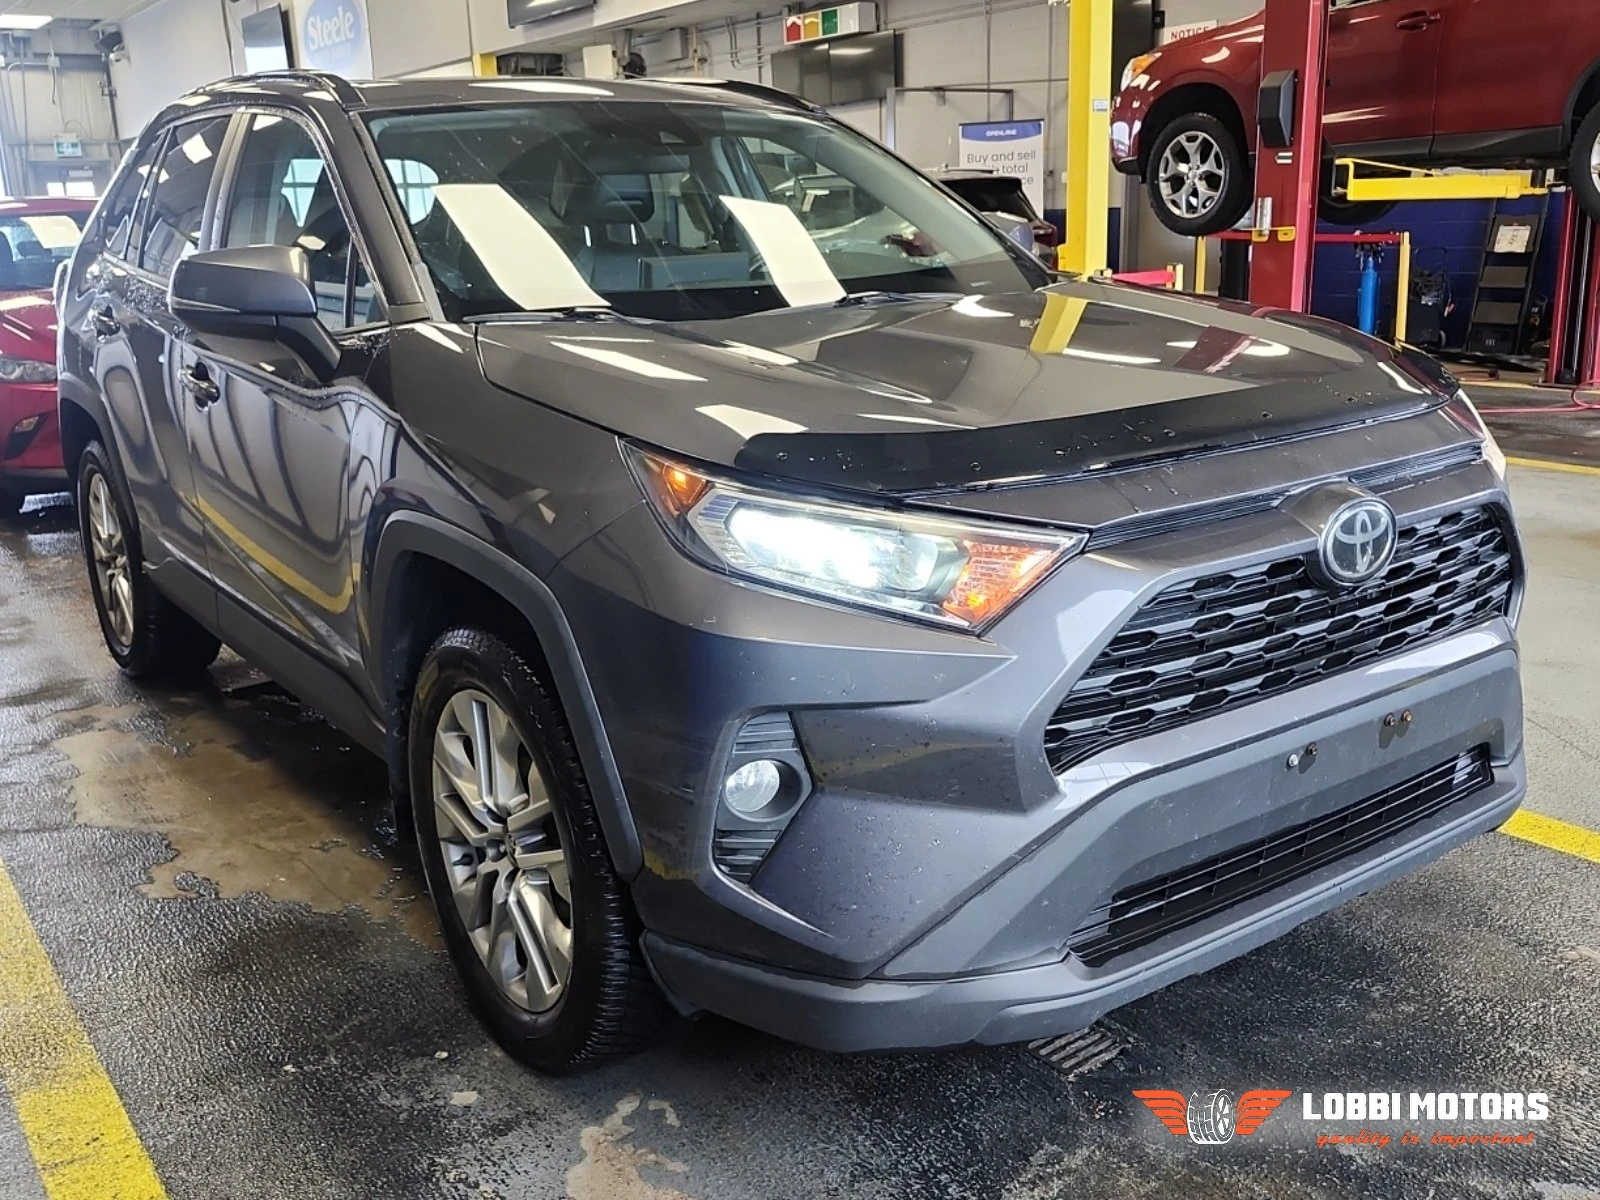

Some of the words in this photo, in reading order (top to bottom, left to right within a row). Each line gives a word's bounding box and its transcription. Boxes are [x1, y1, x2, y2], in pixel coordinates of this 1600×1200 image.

[308, 5, 355, 51] Steele
[967, 153, 988, 166] Buy
[991, 152, 1014, 162] and
[1017, 149, 1036, 160] sell
[1002, 163, 1028, 174] total
